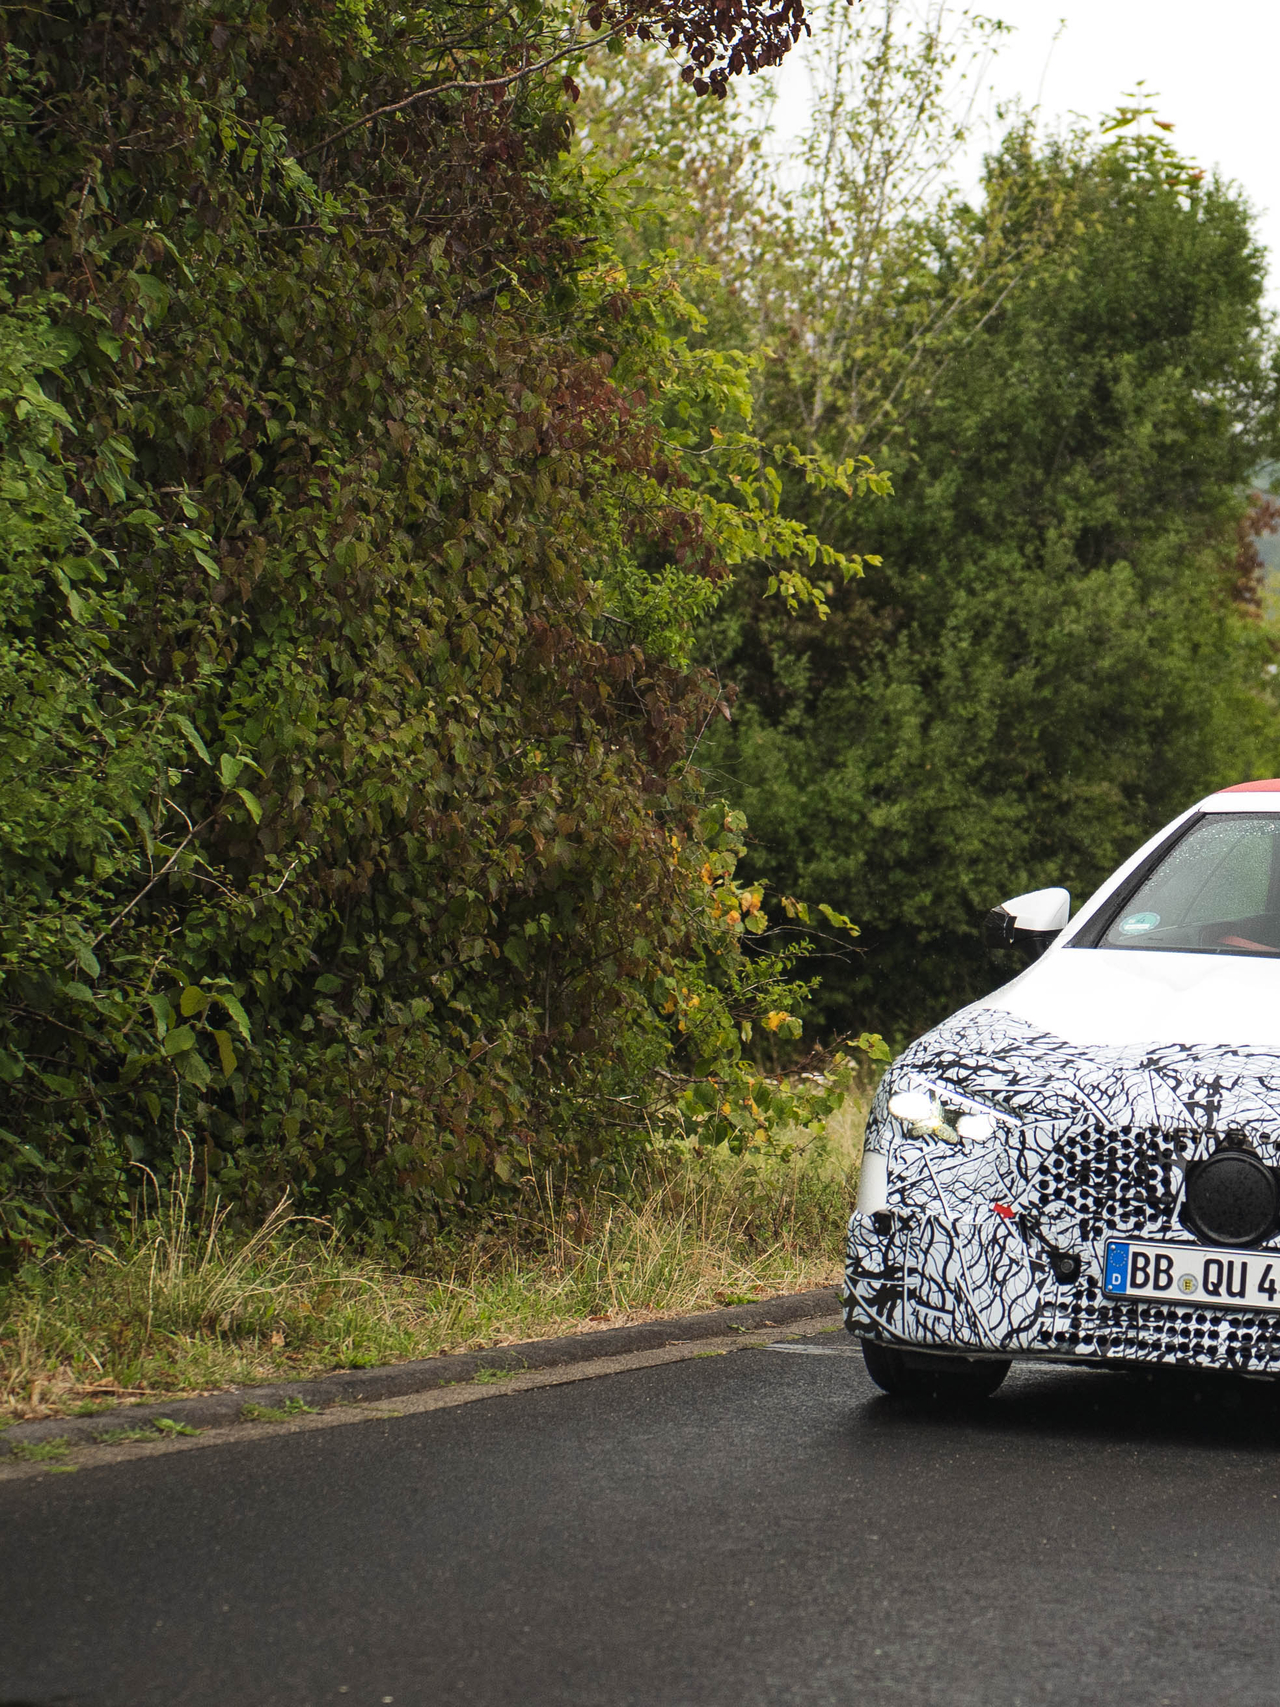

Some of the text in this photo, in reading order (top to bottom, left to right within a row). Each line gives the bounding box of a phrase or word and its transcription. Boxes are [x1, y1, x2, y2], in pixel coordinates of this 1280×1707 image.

[1112, 1273, 1122, 1285] D
[1129, 1251, 1175, 1291] BB
[1202, 1258, 1248, 1299] QU
